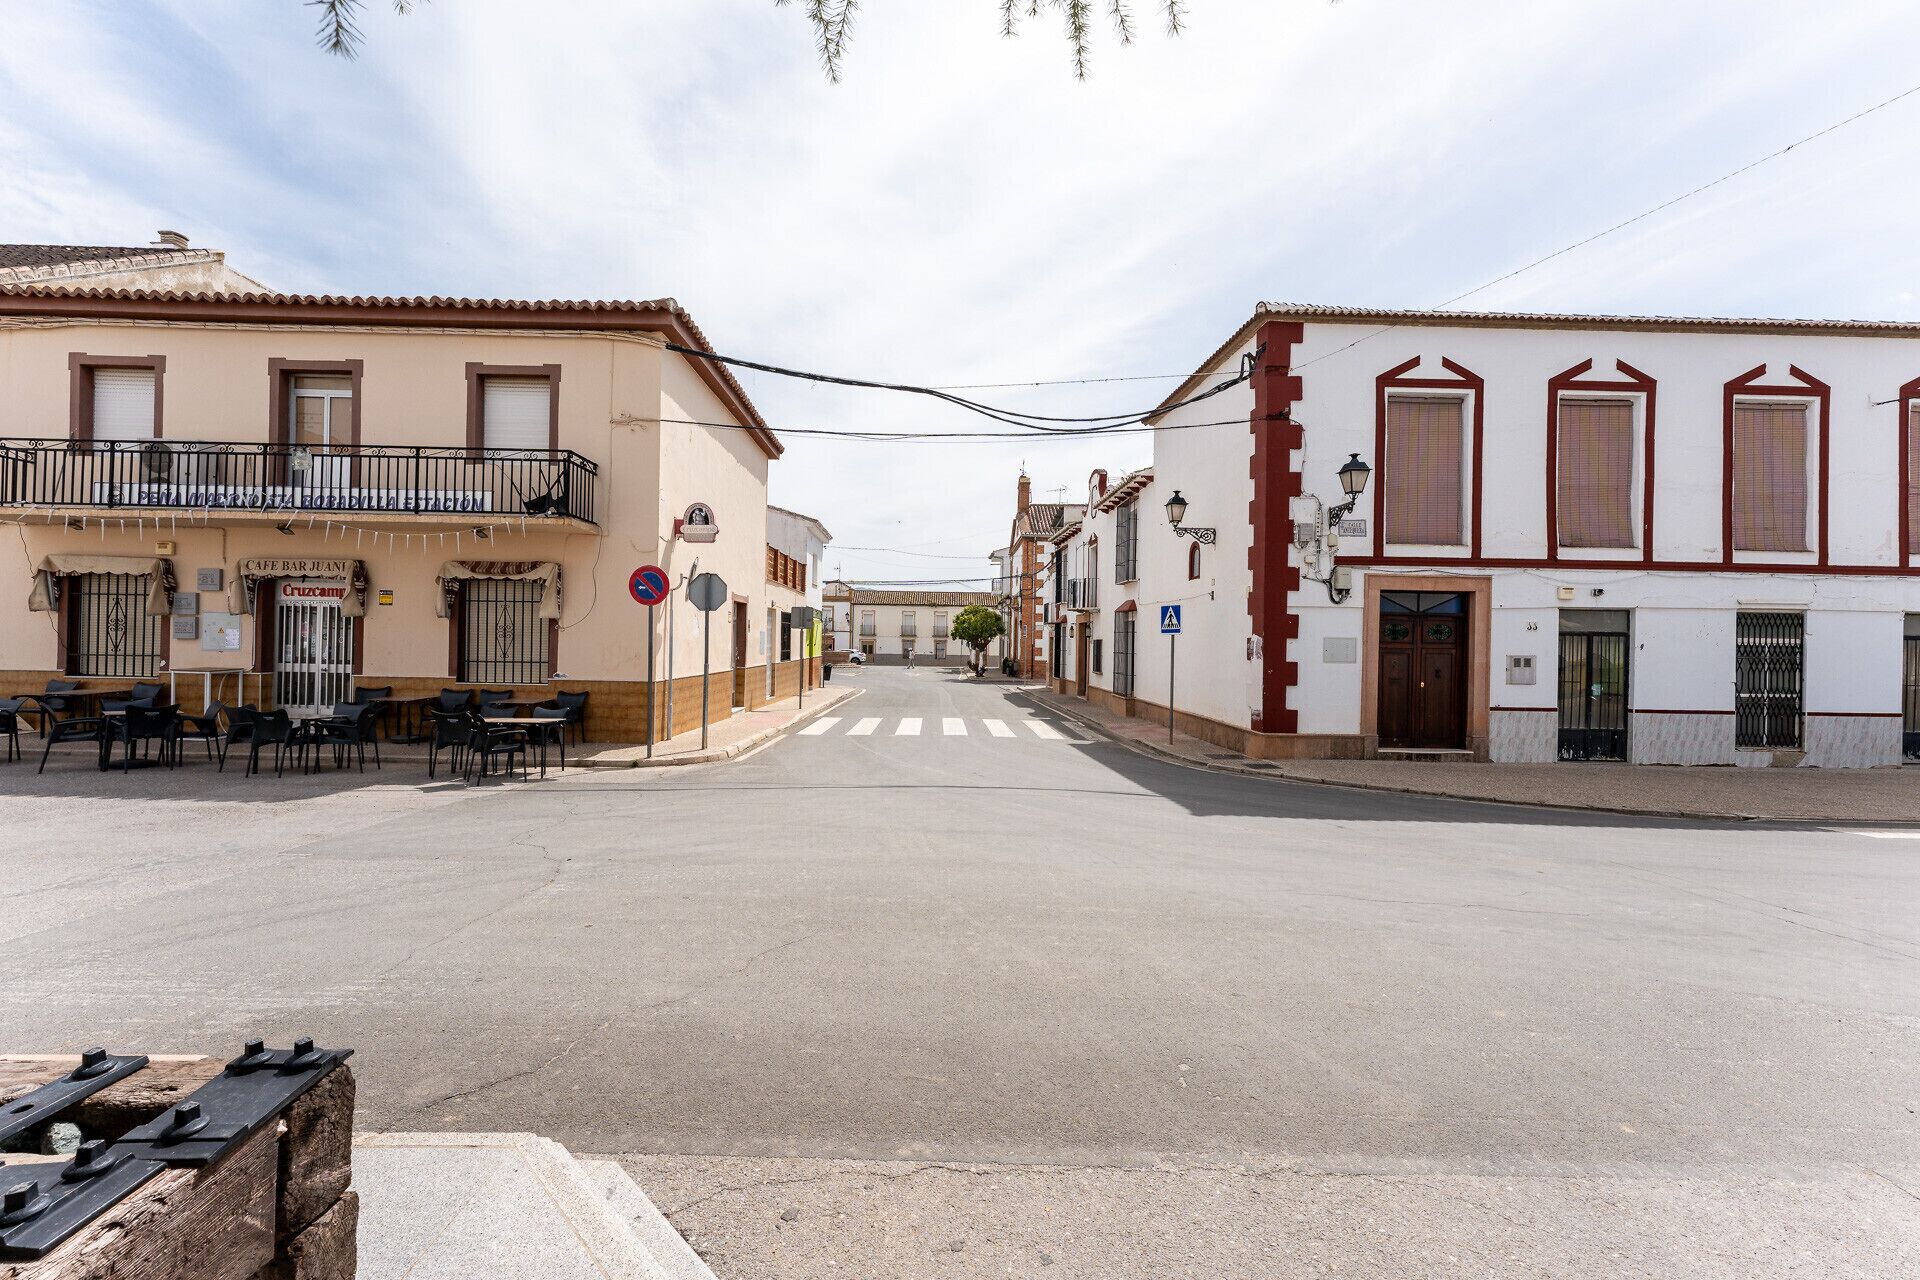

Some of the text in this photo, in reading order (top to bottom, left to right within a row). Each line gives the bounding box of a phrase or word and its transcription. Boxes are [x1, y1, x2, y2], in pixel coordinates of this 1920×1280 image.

[188, 492, 292, 507] MADRDSTA
[302, 494, 396, 509] BOBADILLA
[402, 494, 483, 511] ESTACIÓN
[245, 559, 346, 572] CAFE BAR JUANI
[282, 583, 347, 599] Cruzcamp
